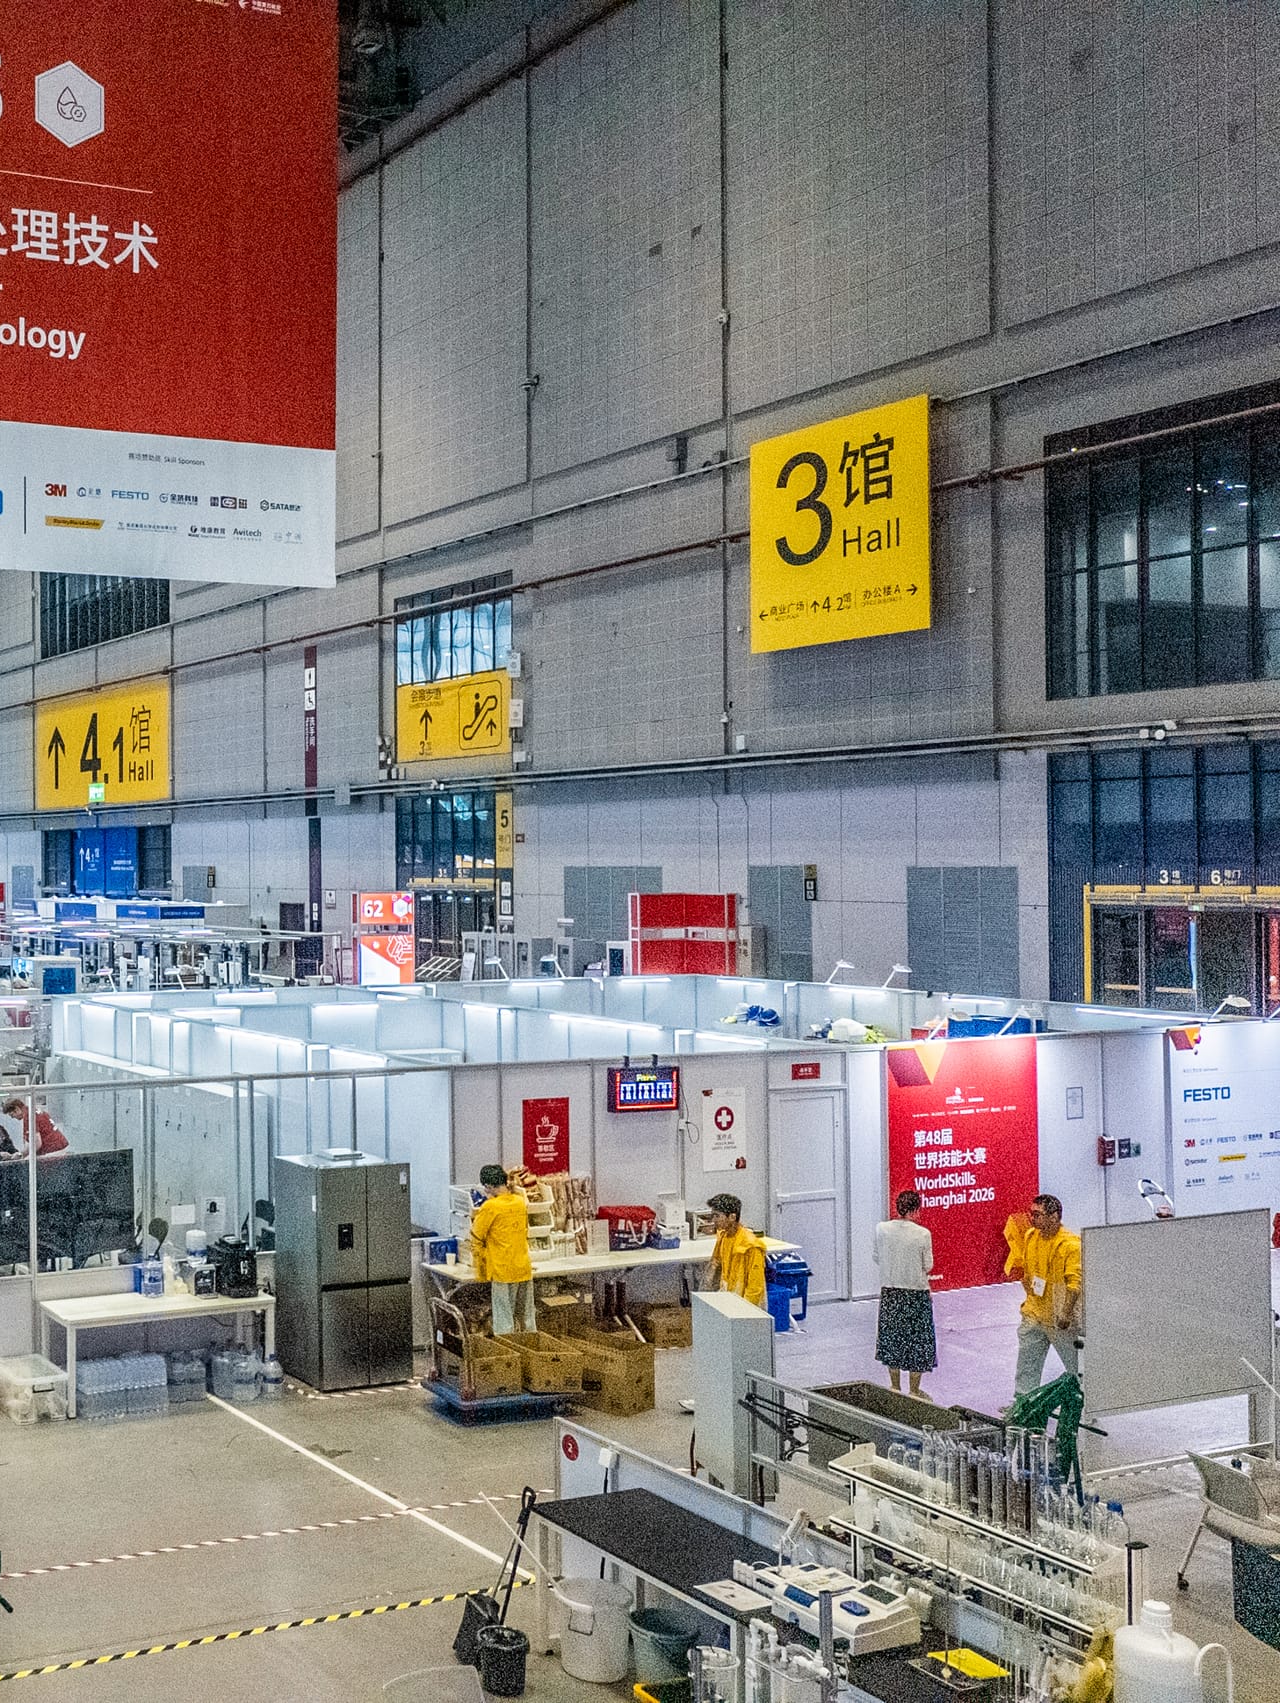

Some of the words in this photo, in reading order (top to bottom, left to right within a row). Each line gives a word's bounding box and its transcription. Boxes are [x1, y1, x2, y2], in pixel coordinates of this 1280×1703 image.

[164, 456, 177, 464] Skill
[178, 458, 205, 467] Sponsors
[838, 432, 895, 509] 馆
[44, 483, 68, 498] 3M
[111, 489, 150, 501] FESTO
[775, 451, 833, 567] 3
[233, 528, 262, 538] Avitech
[843, 518, 901, 557] Hall
[129, 704, 152, 754] 馆
[80, 712, 124, 786] 4.1
[128, 759, 154, 783] Hall
[501, 809, 509, 829] 5
[1159, 869, 1169, 885] 3
[1210, 869, 1221, 885] 6
[363, 899, 384, 918] 62
[1183, 1086, 1231, 1103] FESTO
[914, 1128, 953, 1148] 第48届
[1183, 1138, 1196, 1148] 3M
[914, 1147, 987, 1170] 世界技能大赛
[914, 1171, 977, 1191] WorldSkills
[919, 1189, 967, 1210] hanghai
[968, 1187, 996, 1204] 2026
